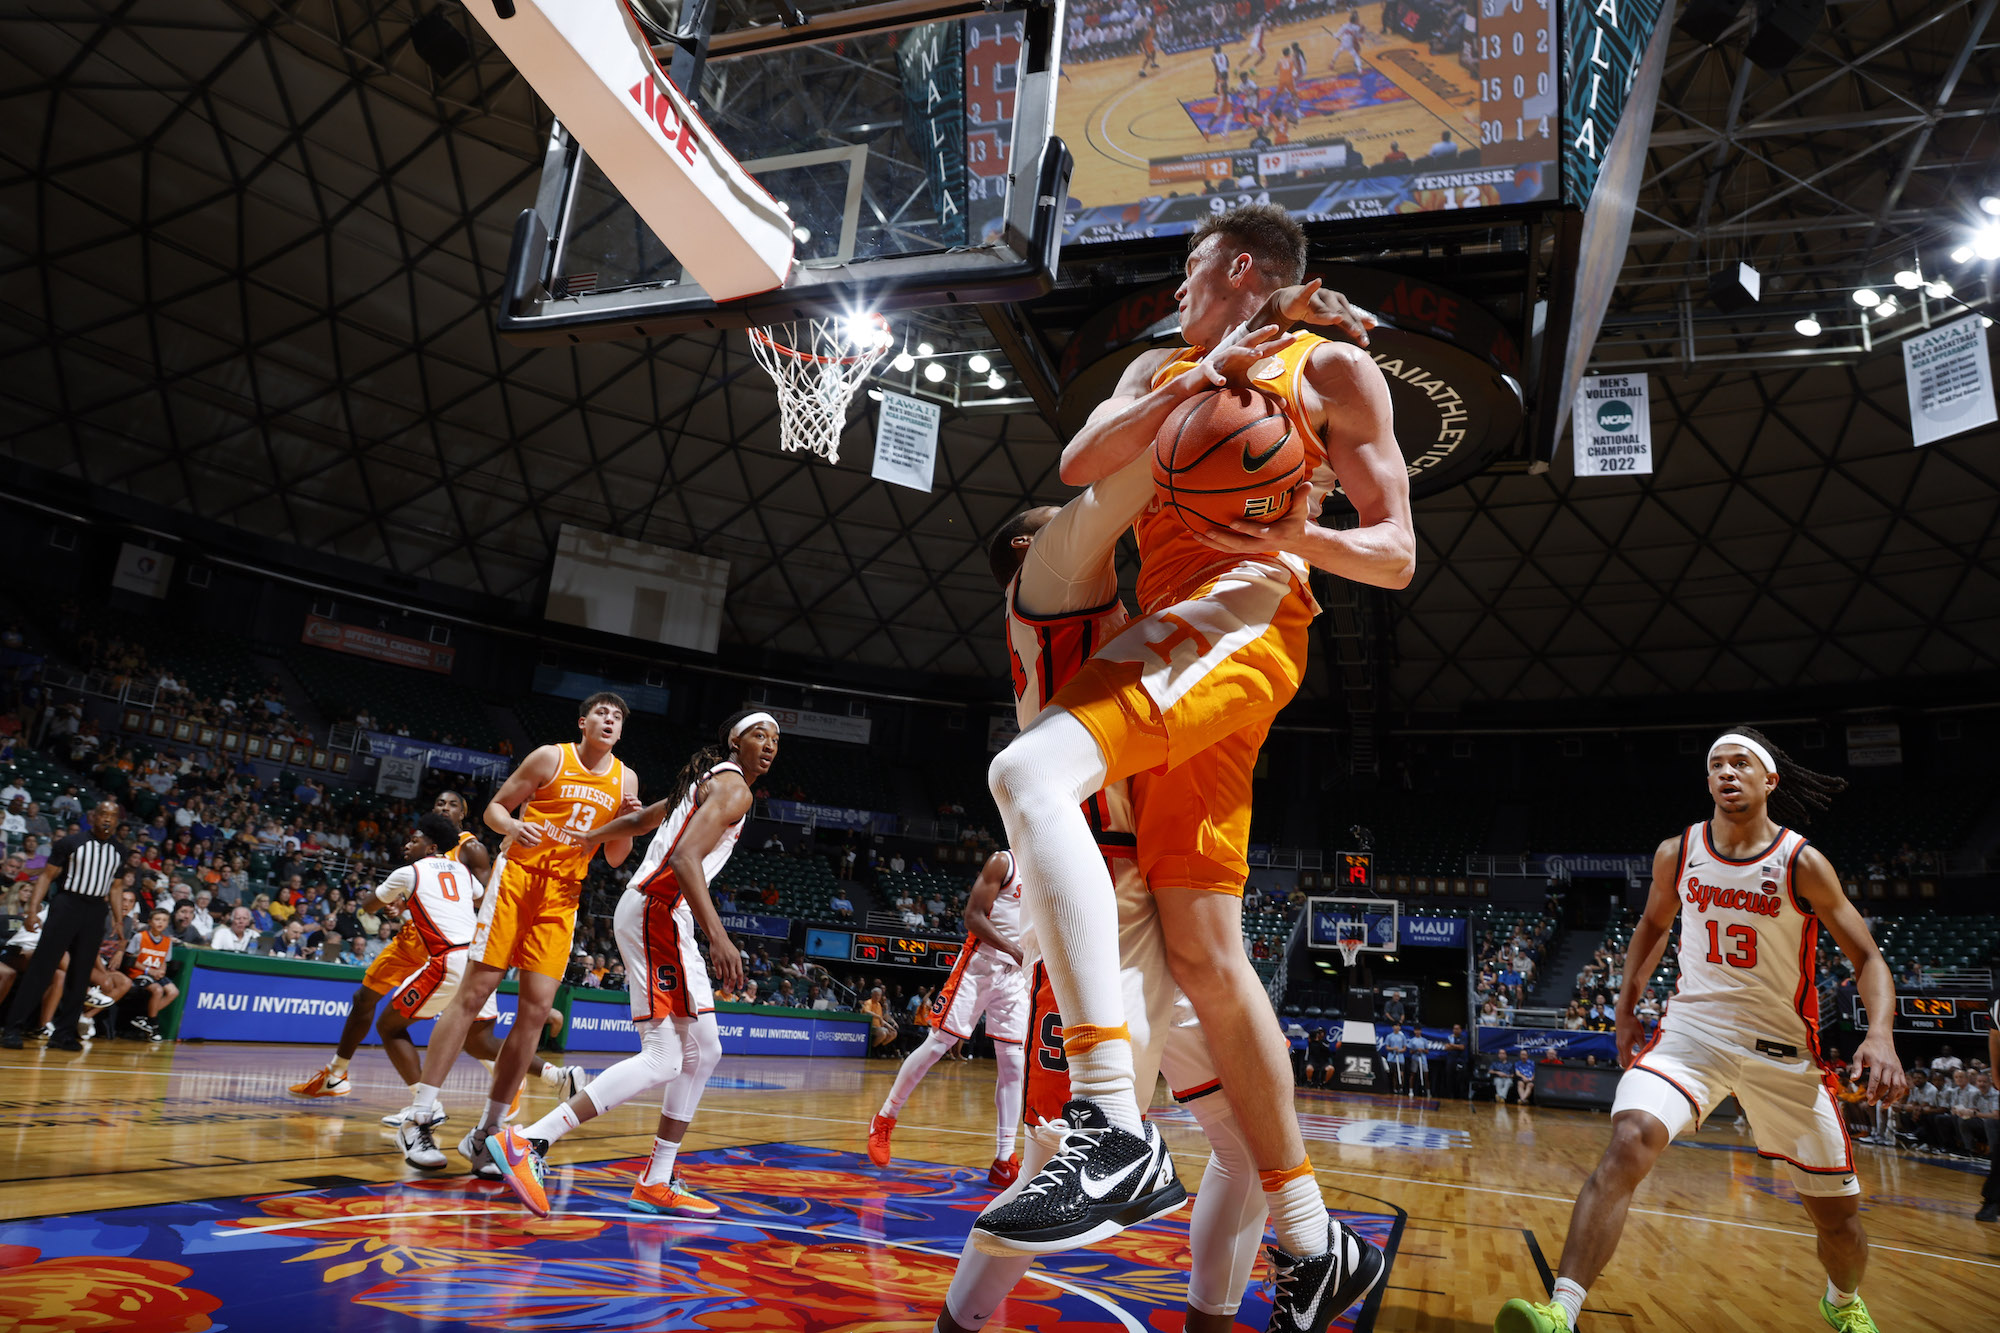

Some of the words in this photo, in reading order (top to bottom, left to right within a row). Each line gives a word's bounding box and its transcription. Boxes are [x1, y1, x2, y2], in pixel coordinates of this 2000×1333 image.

[1481, 34, 1501, 60] 13
[1512, 32, 1524, 56] 0
[1536, 29, 1548, 53] 2
[1481, 77, 1502, 102] 15
[1513, 74, 1525, 99] 0
[1537, 72, 1549, 96] 0
[628, 71, 699, 167] ACE
[921, 36, 958, 225] MALIA
[1481, 120, 1503, 145] 30
[1515, 117, 1525, 141] 1
[1538, 114, 1550, 139] 4
[969, 140, 987, 163] 13
[1211, 161, 1229, 176] 12
[1264, 156, 1281, 169] 19
[968, 178, 987, 200] 24
[1414, 170, 1515, 190] TENNESSEE
[1443, 186, 1481, 210] 12
[1379, 279, 1460, 332] ACE
[1586, 387, 1643, 399] VOLLEYBALL
[1599, 377, 1629, 389] MEN'S
[1600, 414, 1633, 426] NCAA
[1593, 434, 1640, 446] NATIONAL
[1587, 444, 1647, 457] CHAMPIONS
[1600, 457, 1636, 472] 2022
[430, 748, 463, 761] DUKE'S
[388, 761, 415, 778] 25
[559, 784, 616, 812] TENNESSEE
[565, 802, 597, 832] 13
[794, 802, 843, 818] hmsa
[438, 871, 460, 902] 0
[1686, 876, 1782, 918] Syracuse
[1409, 920, 1455, 936] MAUI
[1705, 919, 1758, 969] 13
[657, 964, 678, 992] S
[197, 991, 249, 1011] MAUI
[403, 989, 420, 1008] S
[932, 995, 947, 1015] S
[571, 1017, 599, 1030] MAUI
[1912, 1020, 1934, 1028] PERIOD
[750, 1028, 767, 1038] MAUI
[768, 1029, 810, 1040] INVITATIONAL
[1345, 1056, 1372, 1074] 25
[1546, 1070, 1599, 1092] ACE
